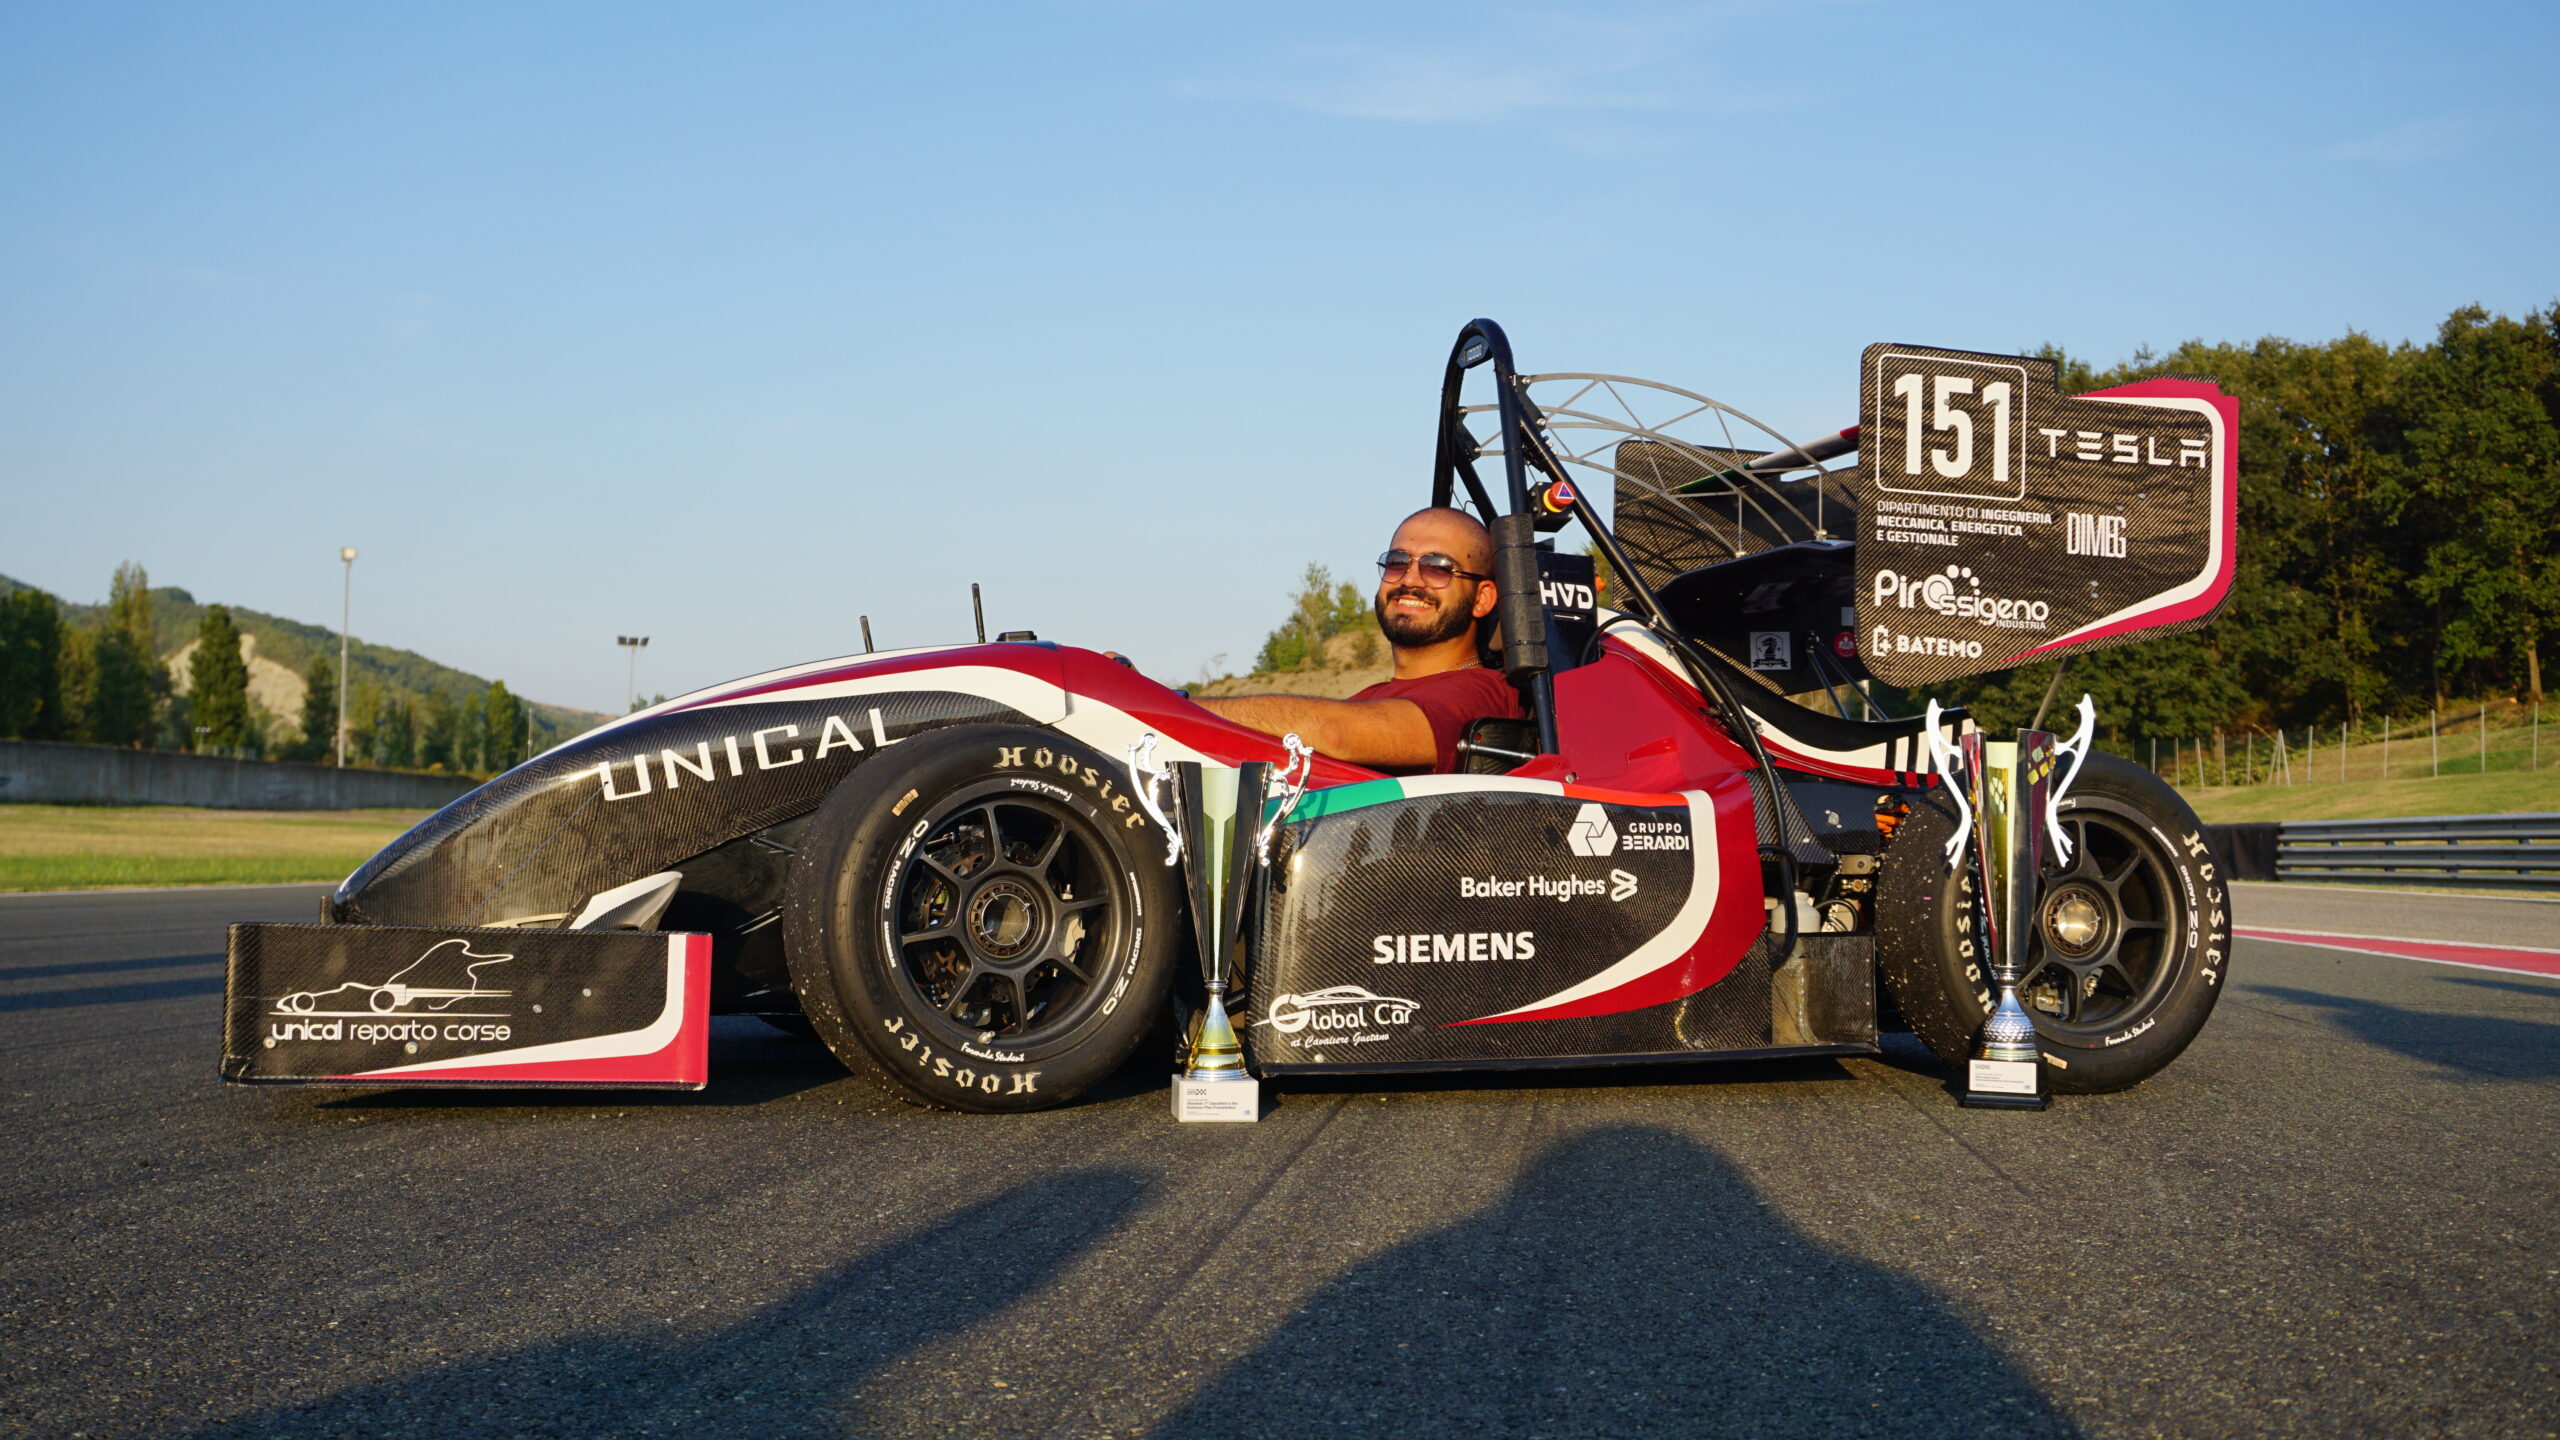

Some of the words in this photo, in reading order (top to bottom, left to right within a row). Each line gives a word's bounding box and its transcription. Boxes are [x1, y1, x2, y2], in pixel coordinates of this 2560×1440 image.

[1894, 373, 2011, 482] 151
[2039, 428, 2206, 468] TESLA
[1877, 501, 1964, 517] DIPARTIMENTO
[1967, 508, 1978, 519] DI
[1981, 508, 2052, 524] INGEGNERIA
[1877, 515, 1948, 532] MECCANICA,
[1951, 521, 2023, 536] ENERGETICA
[1876, 530, 1884, 541] E
[1886, 531, 1958, 546] GESTIONALE
[2067, 512, 2127, 559] DIMEG
[1538, 580, 1593, 610] HVD
[1996, 620, 2046, 630] INDUSTRIA
[1897, 634, 1982, 659] BATEMO
[598, 708, 907, 801] UNICAL
[993, 746, 1145, 829] Hoosier
[1622, 835, 1689, 851] BERARDI
[1628, 822, 1682, 834] GRUPPO
[884, 859, 901, 910] RACING
[1461, 876, 1526, 898] Baker
[1529, 873, 1605, 902] Hughes
[2180, 864, 2197, 906] RACING
[2182, 829, 2225, 987] Hoosier
[1127, 927, 1143, 975] RACING
[1373, 931, 1535, 965] SIEMENS
[1269, 993, 1368, 1034] Global
[1374, 1003, 1412, 1025] Car
[272, 1019, 342, 1041] unical
[350, 1022, 437, 1045] reparto
[443, 1023, 511, 1041] corse
[884, 1016, 1042, 1095] Hoosier
[961, 1041, 994, 1060] Formula
[994, 1051, 1025, 1063] Student
